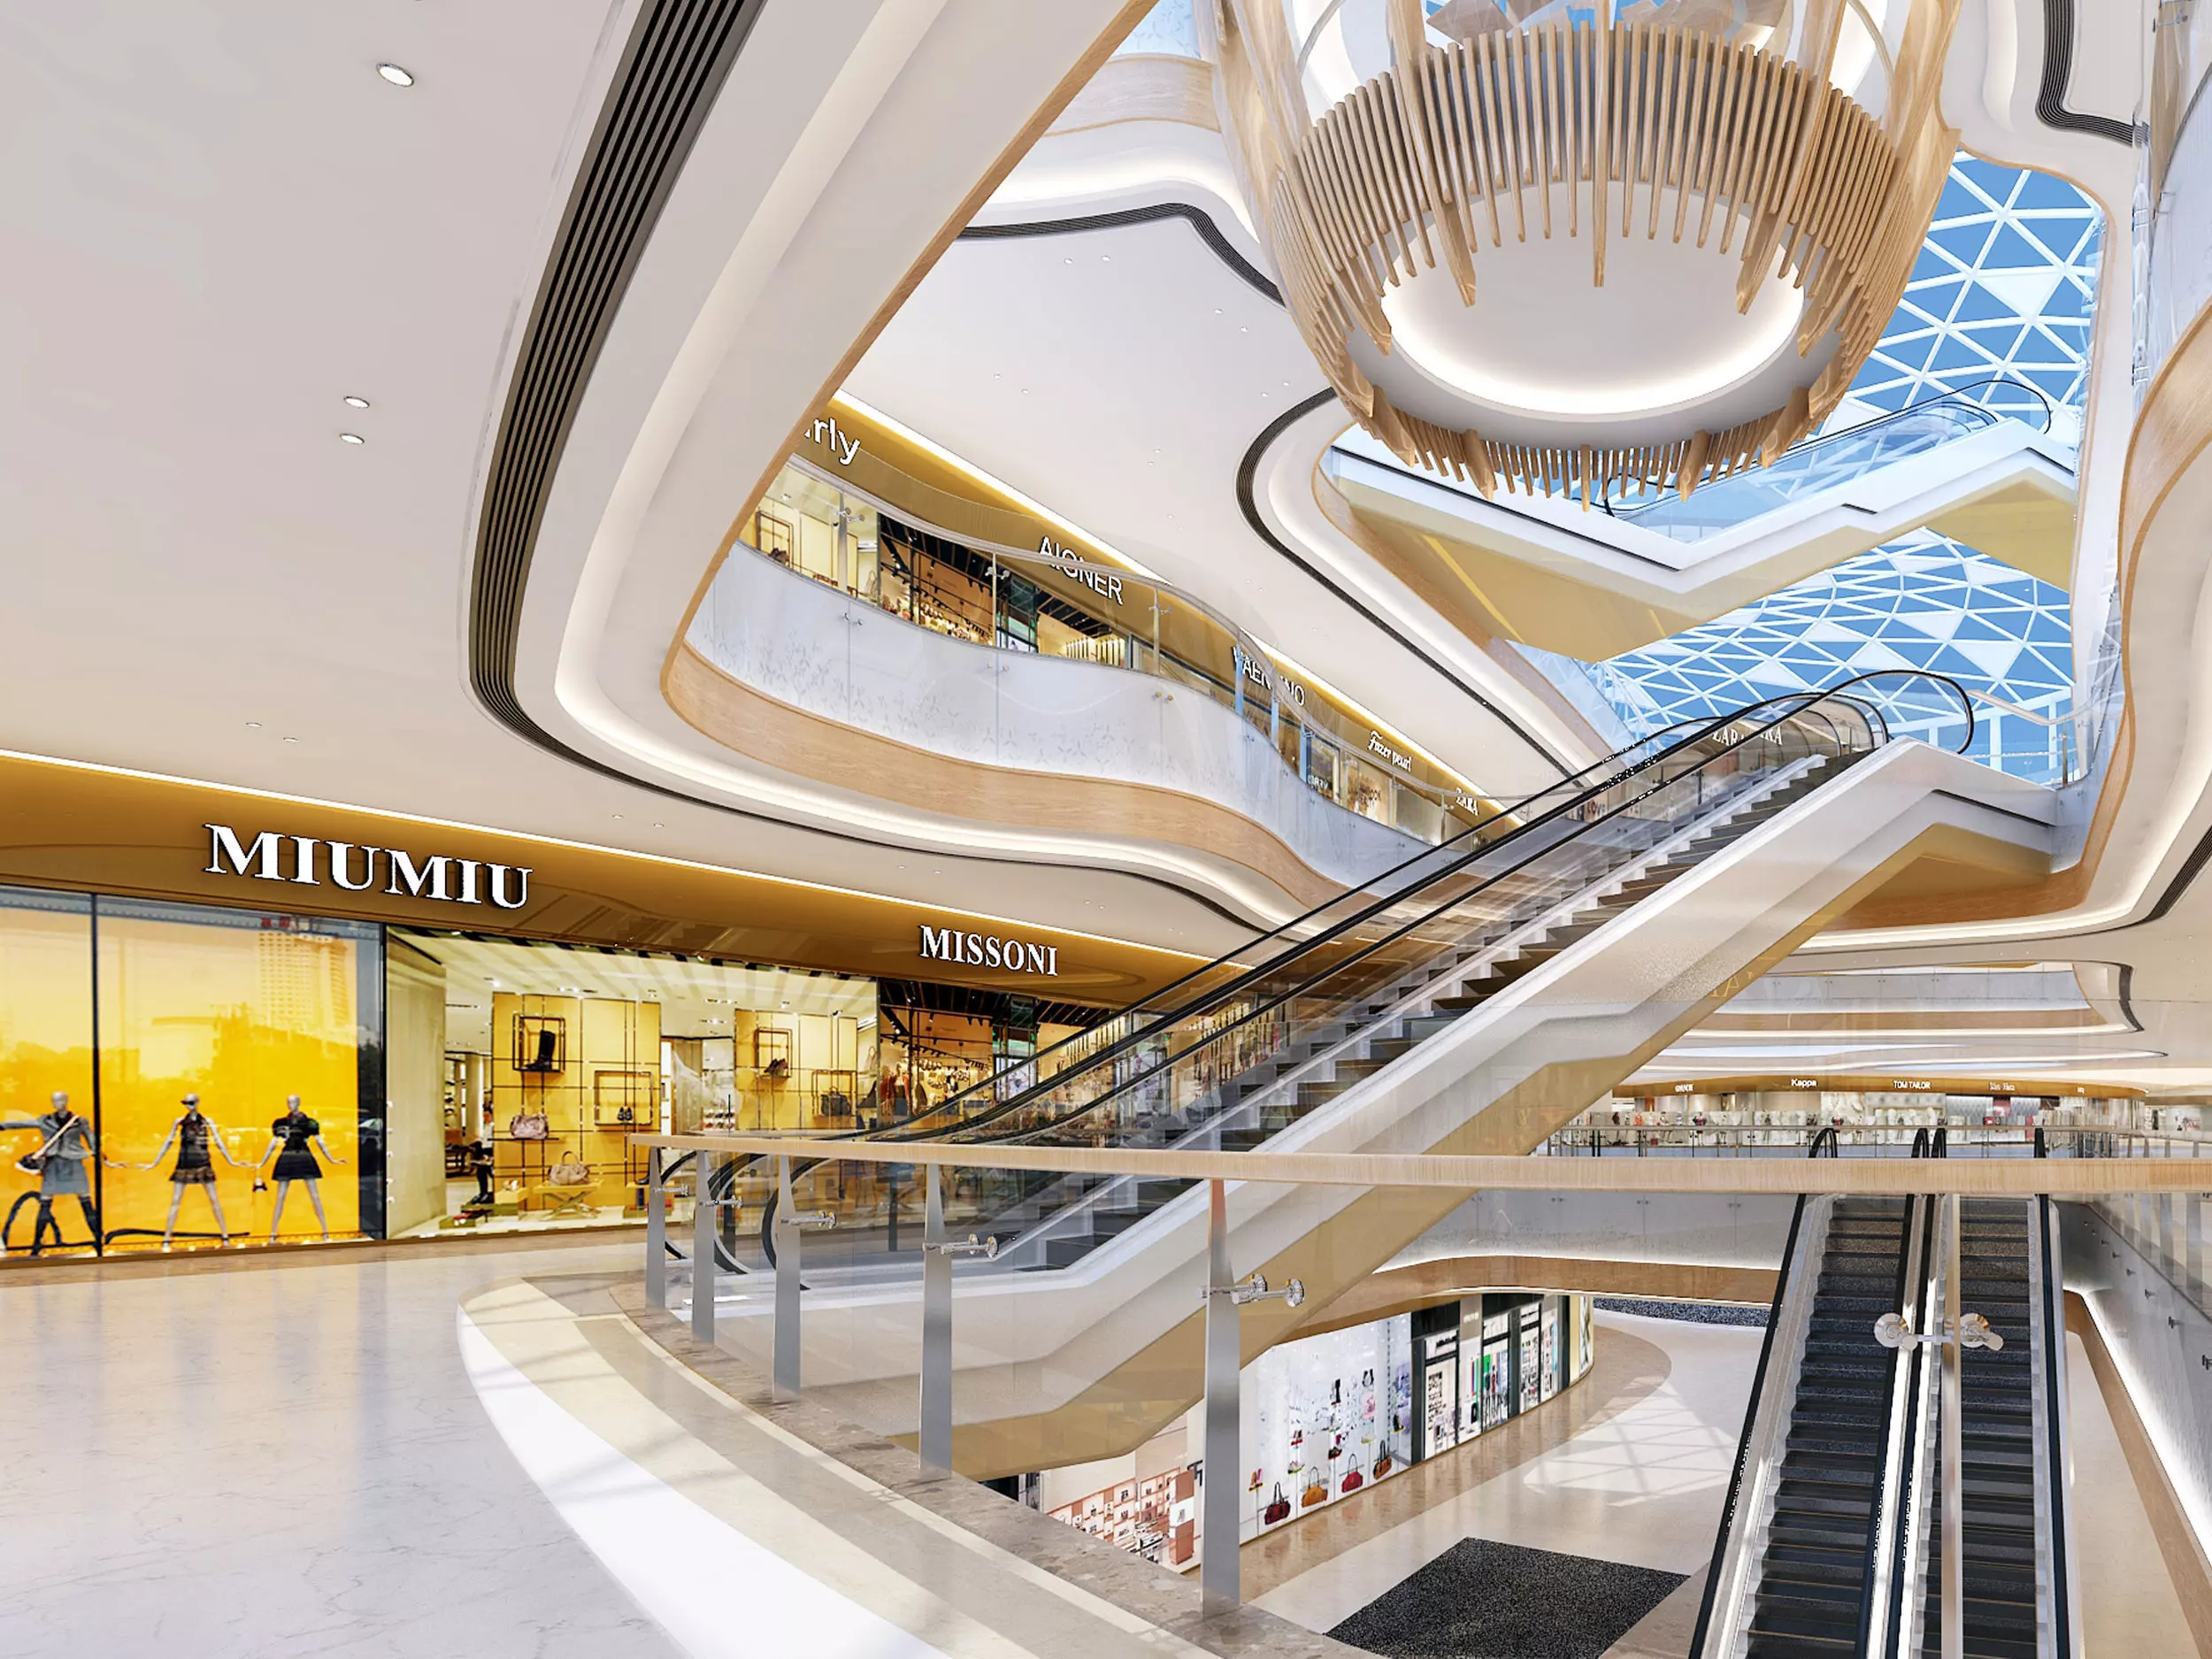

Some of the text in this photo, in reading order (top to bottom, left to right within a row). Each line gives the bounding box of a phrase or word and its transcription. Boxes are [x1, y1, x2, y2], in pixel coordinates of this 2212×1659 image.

[804, 418, 861, 465] rly
[1039, 535, 1124, 605] AIGNER
[204, 823, 534, 910] MIUMIU
[919, 924, 1058, 977] MISSONI
[1790, 1078, 1818, 1088] Kappa
[1893, 1079, 1932, 1090] TOM TAILOR
